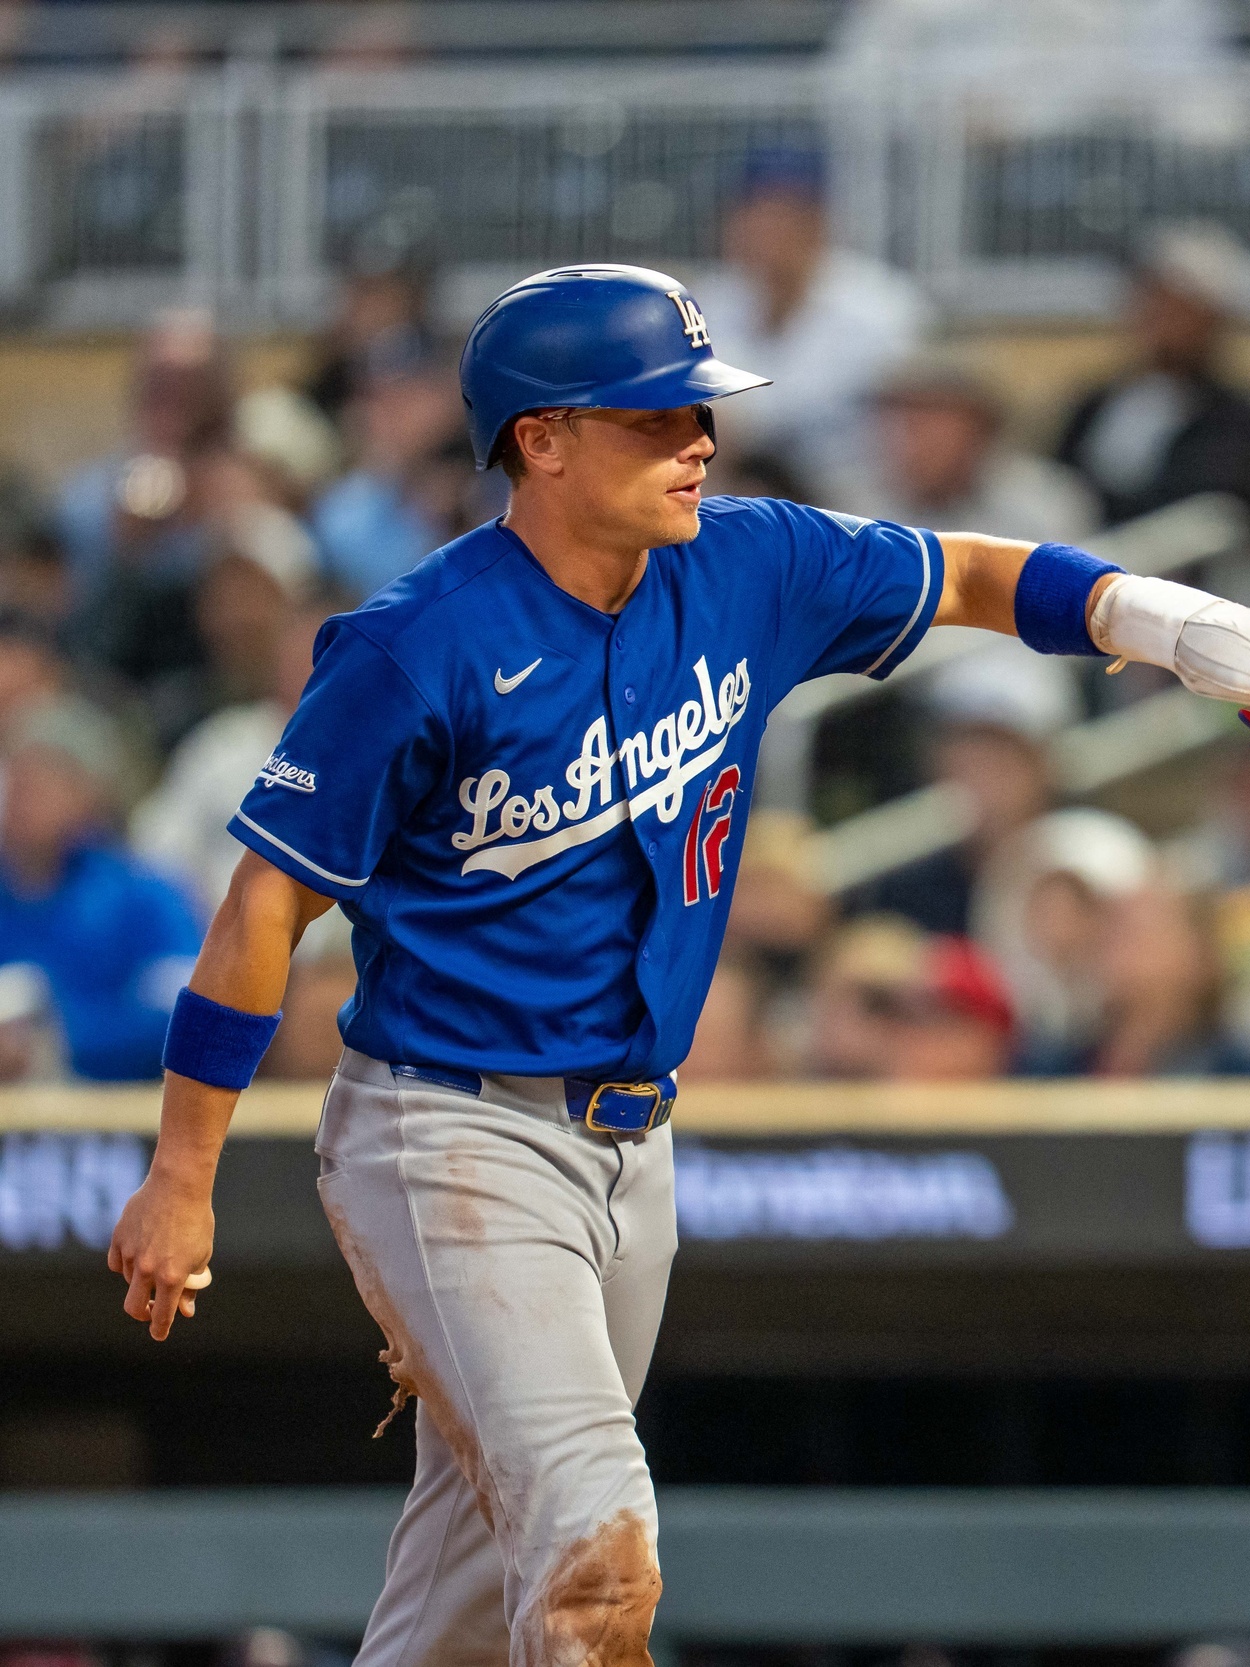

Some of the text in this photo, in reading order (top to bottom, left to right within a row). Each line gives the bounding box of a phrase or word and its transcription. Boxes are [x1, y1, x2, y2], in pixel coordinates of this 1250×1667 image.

[665, 290, 711, 348] LA
[451, 655, 751, 850] Los Angeles
[683, 764, 744, 906] 12
